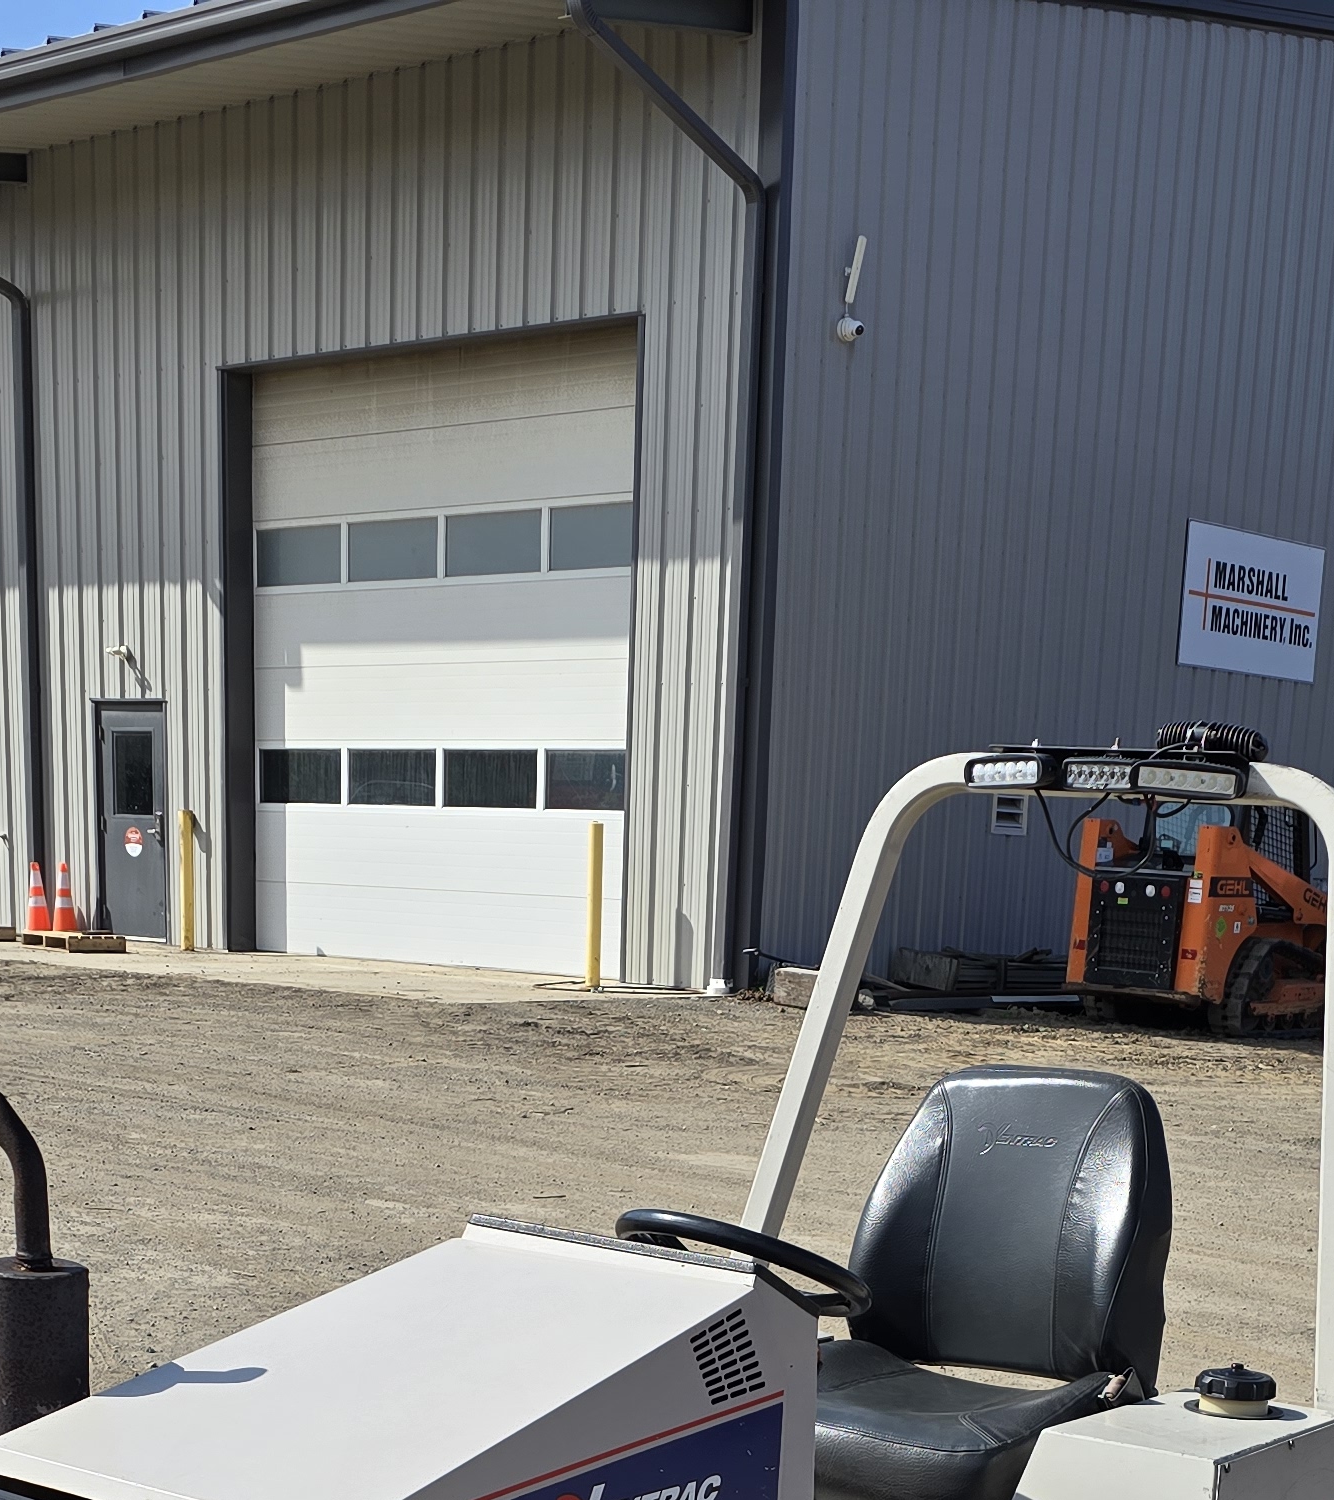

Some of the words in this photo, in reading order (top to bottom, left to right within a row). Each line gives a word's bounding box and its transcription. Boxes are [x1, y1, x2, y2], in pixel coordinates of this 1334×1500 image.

[1213, 560, 1289, 602] MARSHALL
[1209, 604, 1287, 646] MACHINERY,
[1288, 617, 1313, 649] Inc.
[1217, 879, 1250, 895] GEHL
[1303, 887, 1327, 913] GEH
